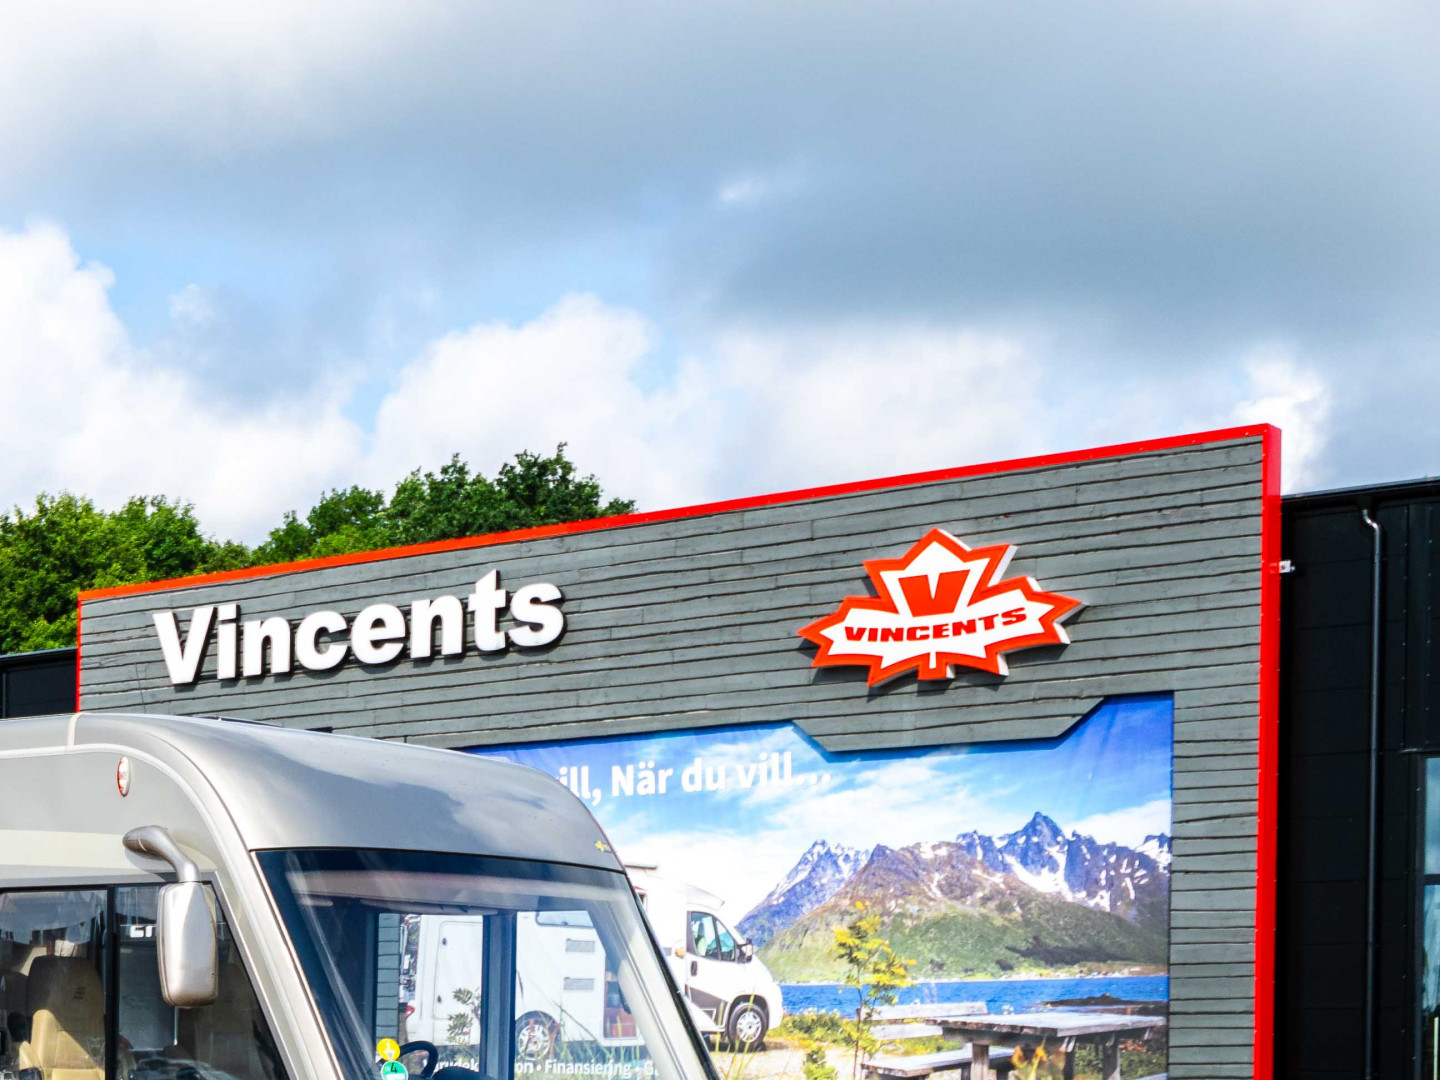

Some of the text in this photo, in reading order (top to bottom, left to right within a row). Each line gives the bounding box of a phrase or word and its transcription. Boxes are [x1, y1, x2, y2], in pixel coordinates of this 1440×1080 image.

[152, 569, 566, 684] Vincents
[844, 606, 1027, 643] VINCENTS
[556, 750, 832, 807] ill, När du vill...
[544, 1059, 632, 1078] Finansiering
